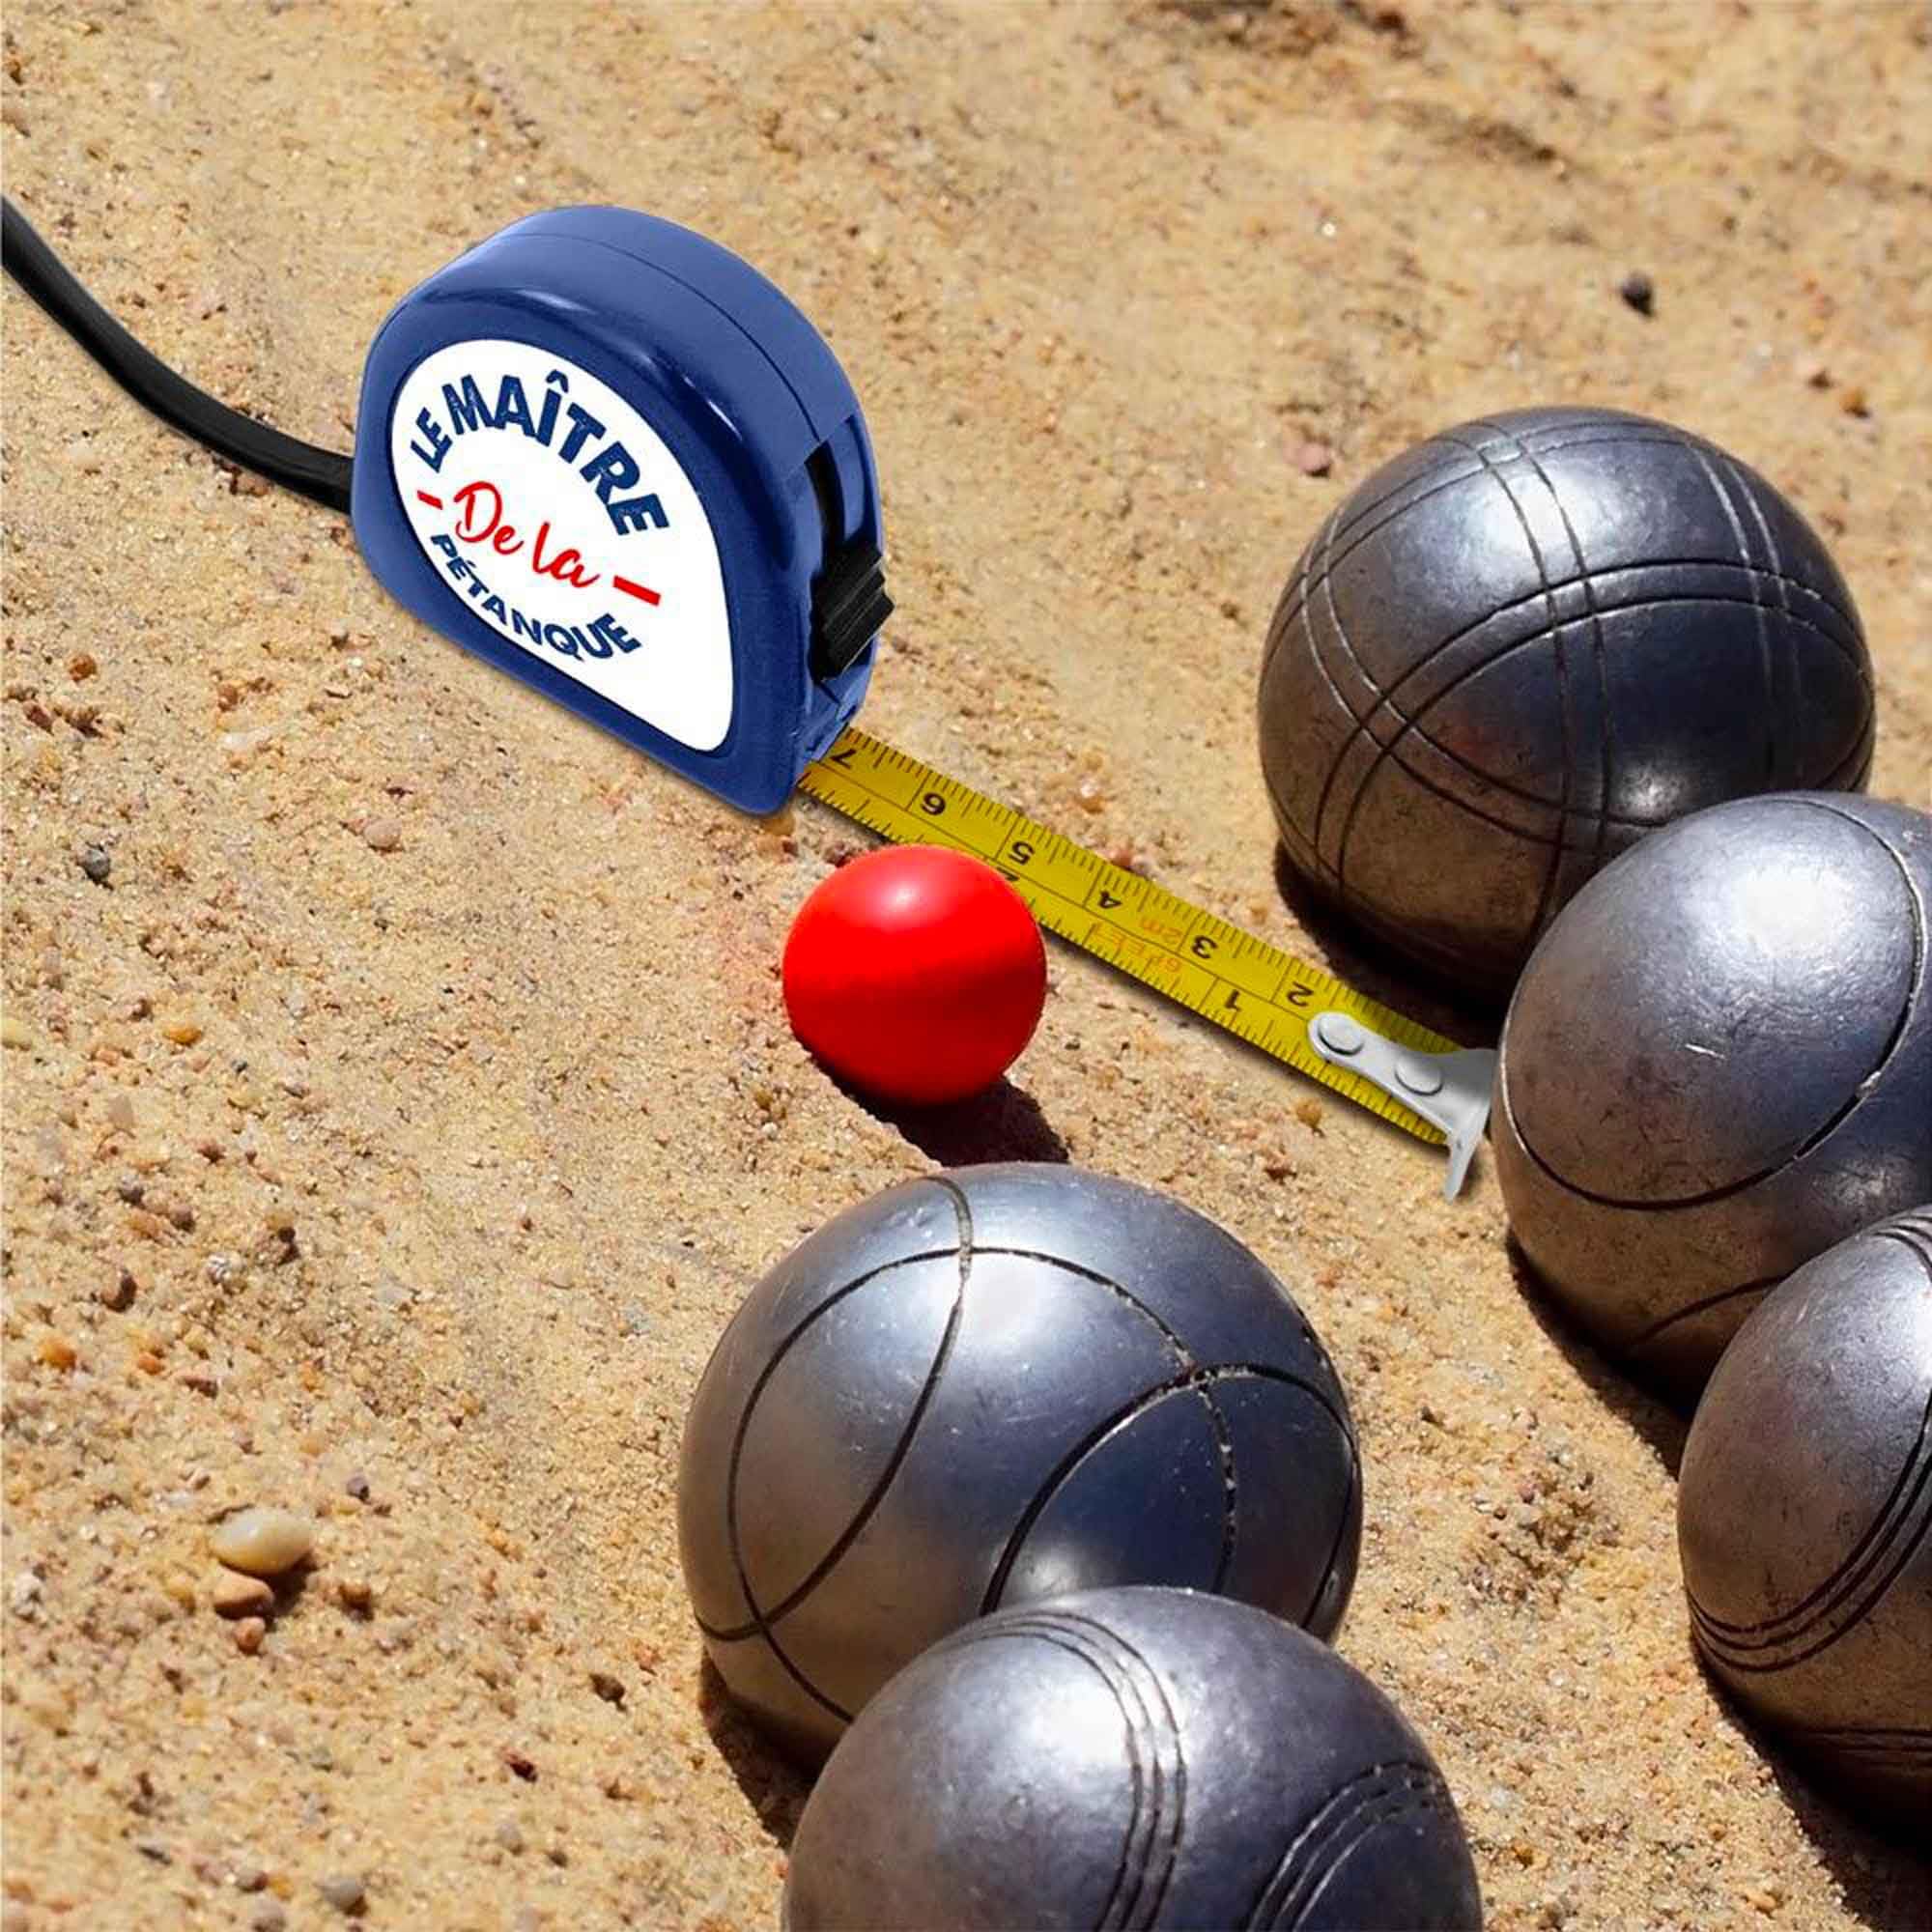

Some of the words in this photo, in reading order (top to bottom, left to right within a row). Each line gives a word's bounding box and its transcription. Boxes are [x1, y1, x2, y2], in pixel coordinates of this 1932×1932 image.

[411, 407, 453, 473] LE
[441, 369, 669, 536] MAÎTRE
[453, 481, 525, 555] De
[532, 522, 602, 587] la
[430, 533, 641, 663] PÉTANQUE
[831, 749, 858, 770] 7
[921, 792, 947, 816] 6
[1009, 841, 1036, 866] 5
[1097, 891, 1123, 910] 4
[1191, 935, 1218, 959] 3
[1224, 990, 1242, 1013] 1
[1288, 981, 1315, 1008] 2
